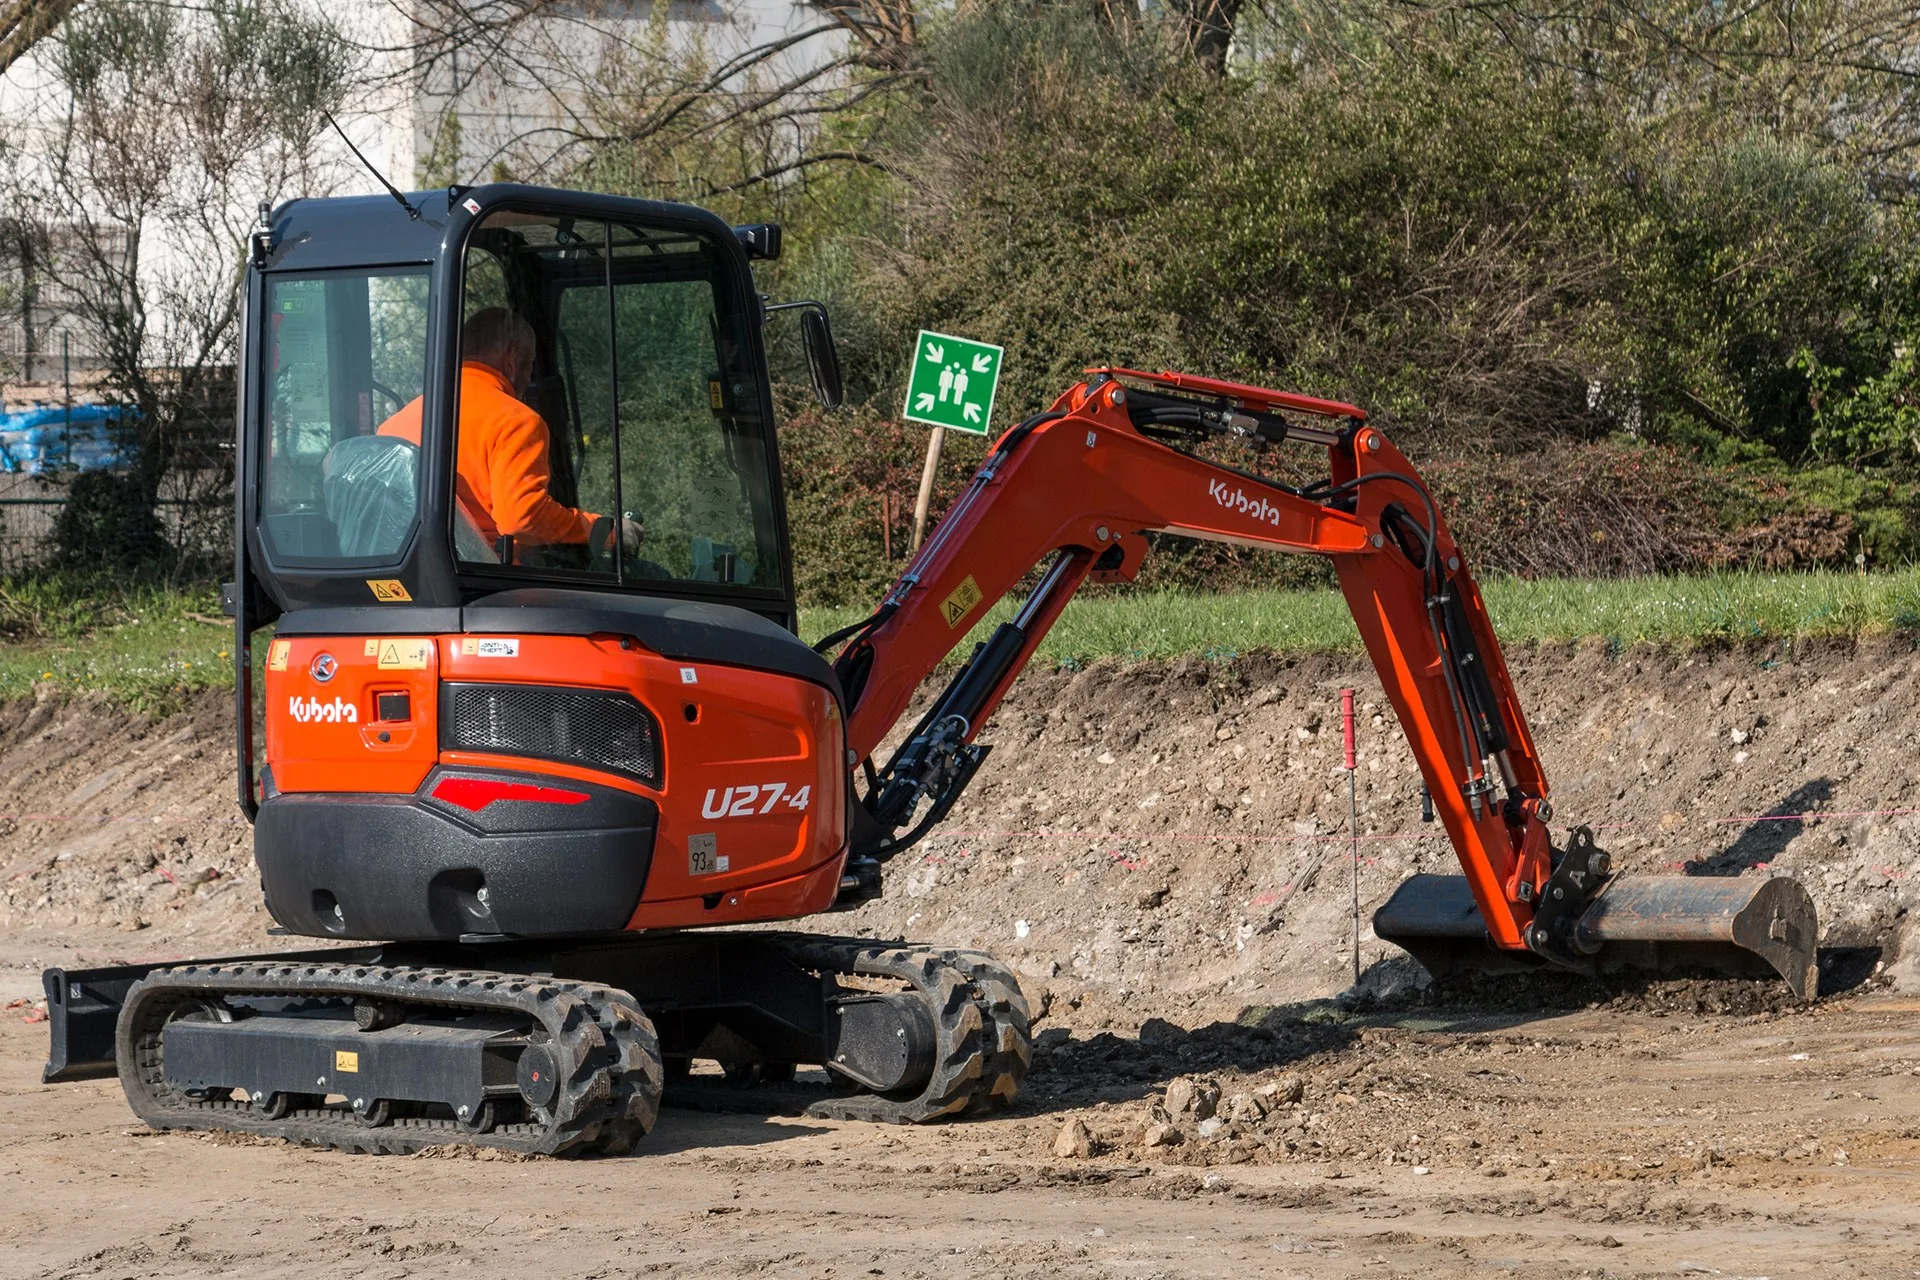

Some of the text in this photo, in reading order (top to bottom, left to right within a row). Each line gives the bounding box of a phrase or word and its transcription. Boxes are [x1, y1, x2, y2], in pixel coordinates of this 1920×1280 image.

[1209, 478, 1279, 526] Kubota
[289, 696, 357, 722] Kubota
[702, 783, 811, 819] U27-4
[692, 851, 706, 871] 93
